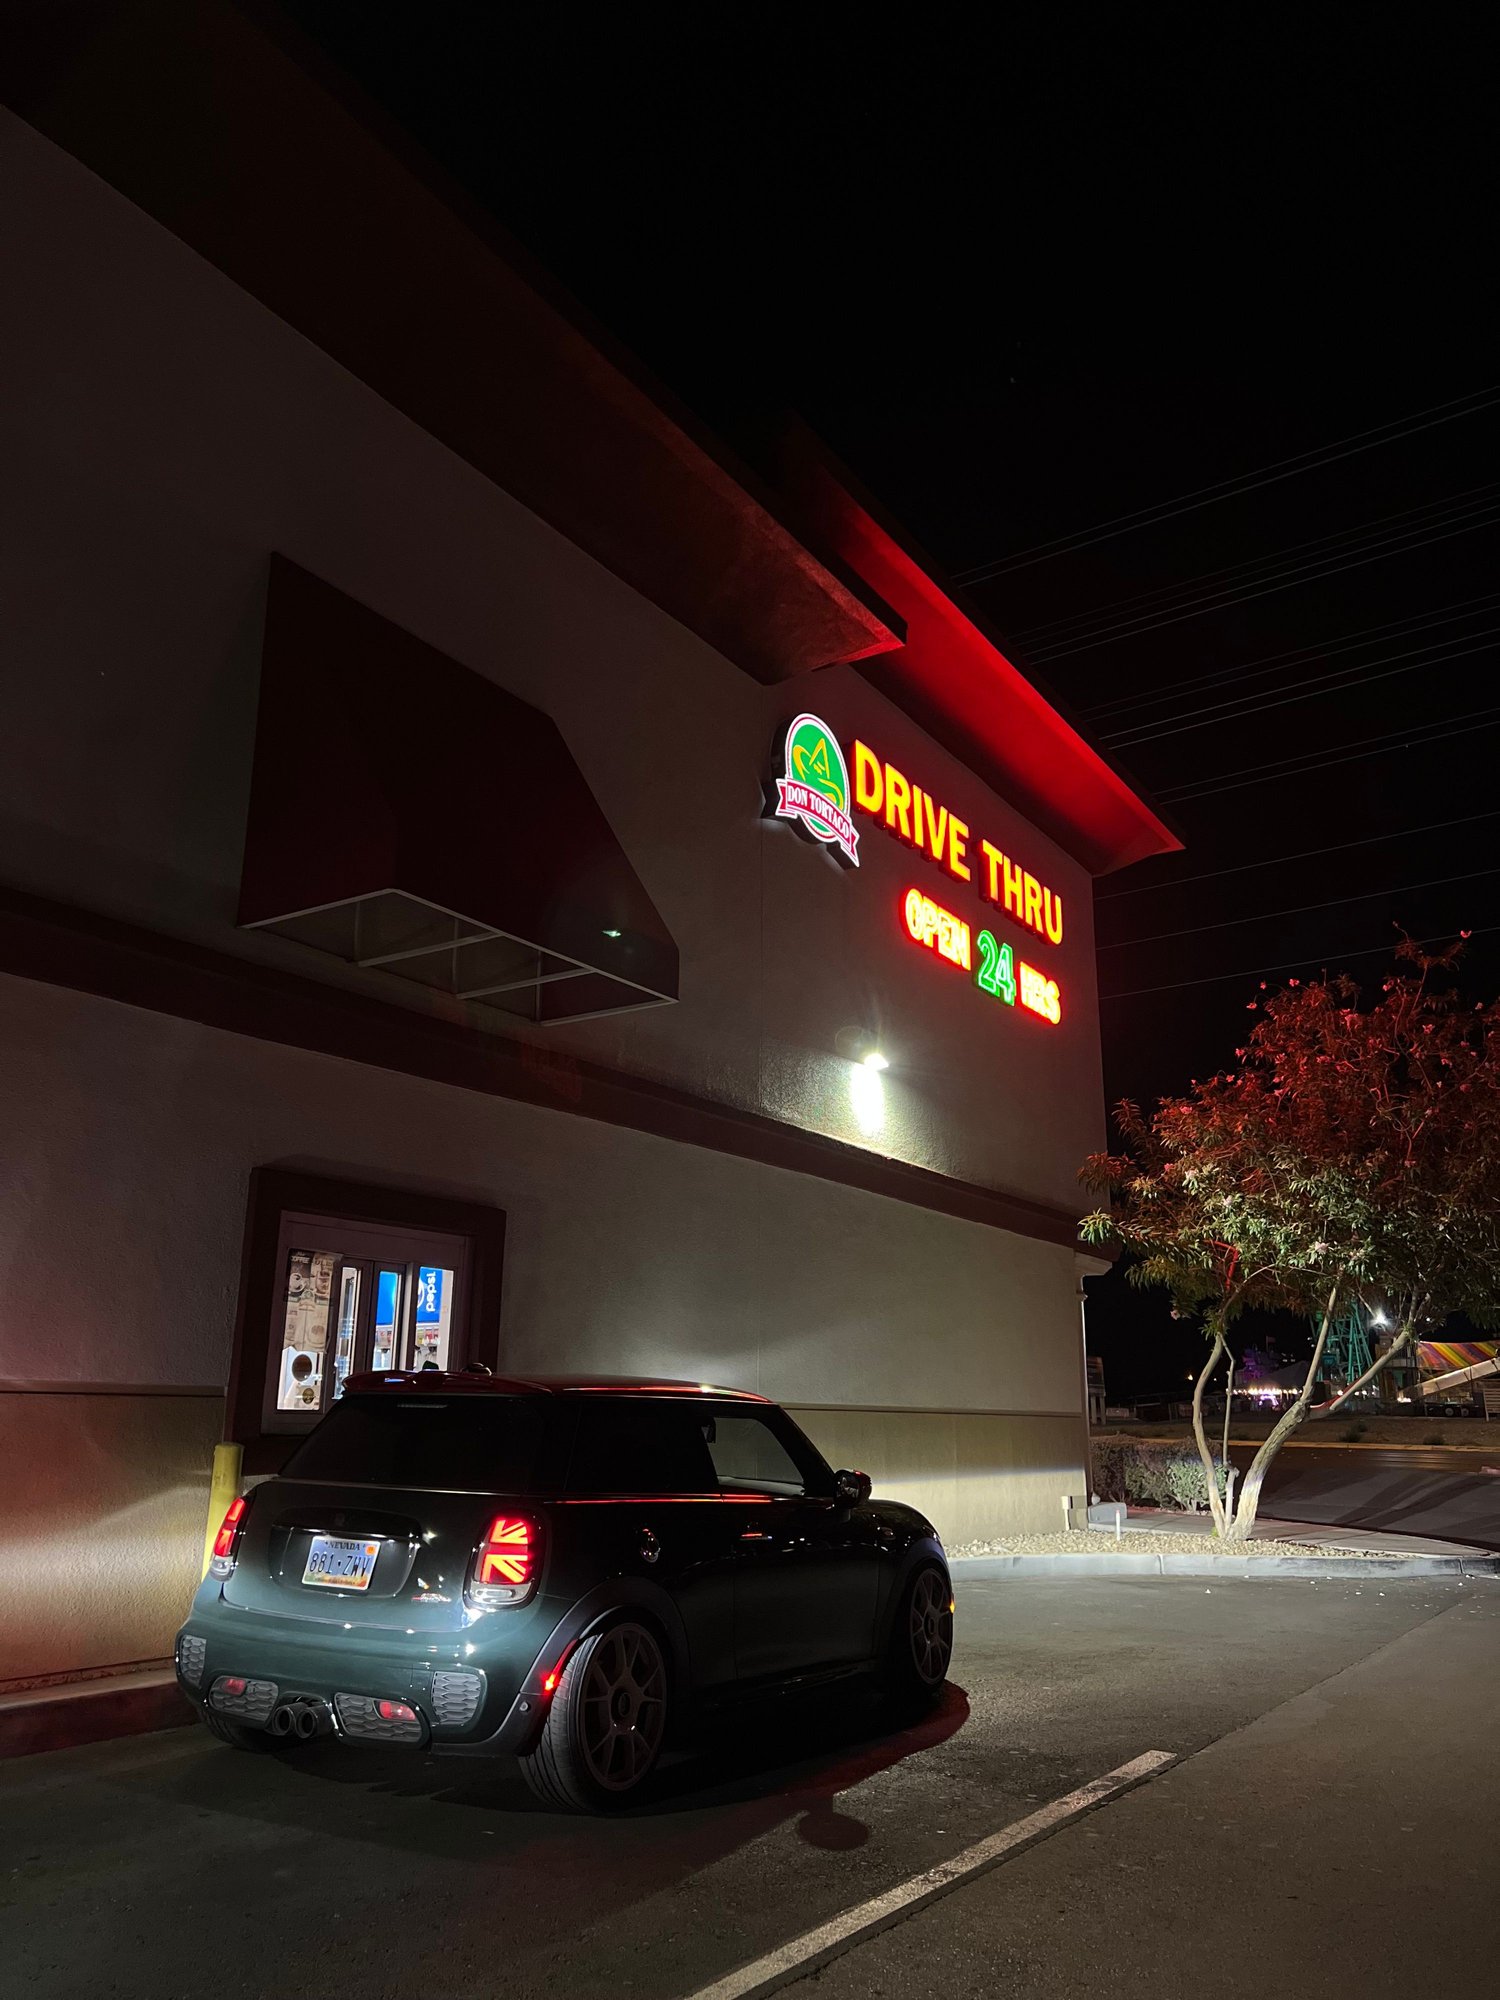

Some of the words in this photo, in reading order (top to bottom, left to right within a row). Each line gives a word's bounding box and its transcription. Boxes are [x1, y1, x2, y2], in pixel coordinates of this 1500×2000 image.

[787, 785, 808, 807] DON
[809, 792, 850, 839] TORTACO
[855, 739, 971, 881] DRIVE
[982, 838, 1063, 945] THRU
[904, 887, 971, 971] OPEN
[976, 928, 1016, 1007] 24
[1019, 960, 1061, 1025] HRS
[426, 1271, 437, 1312] pepsi
[328, 1541, 361, 1551] NEVADA
